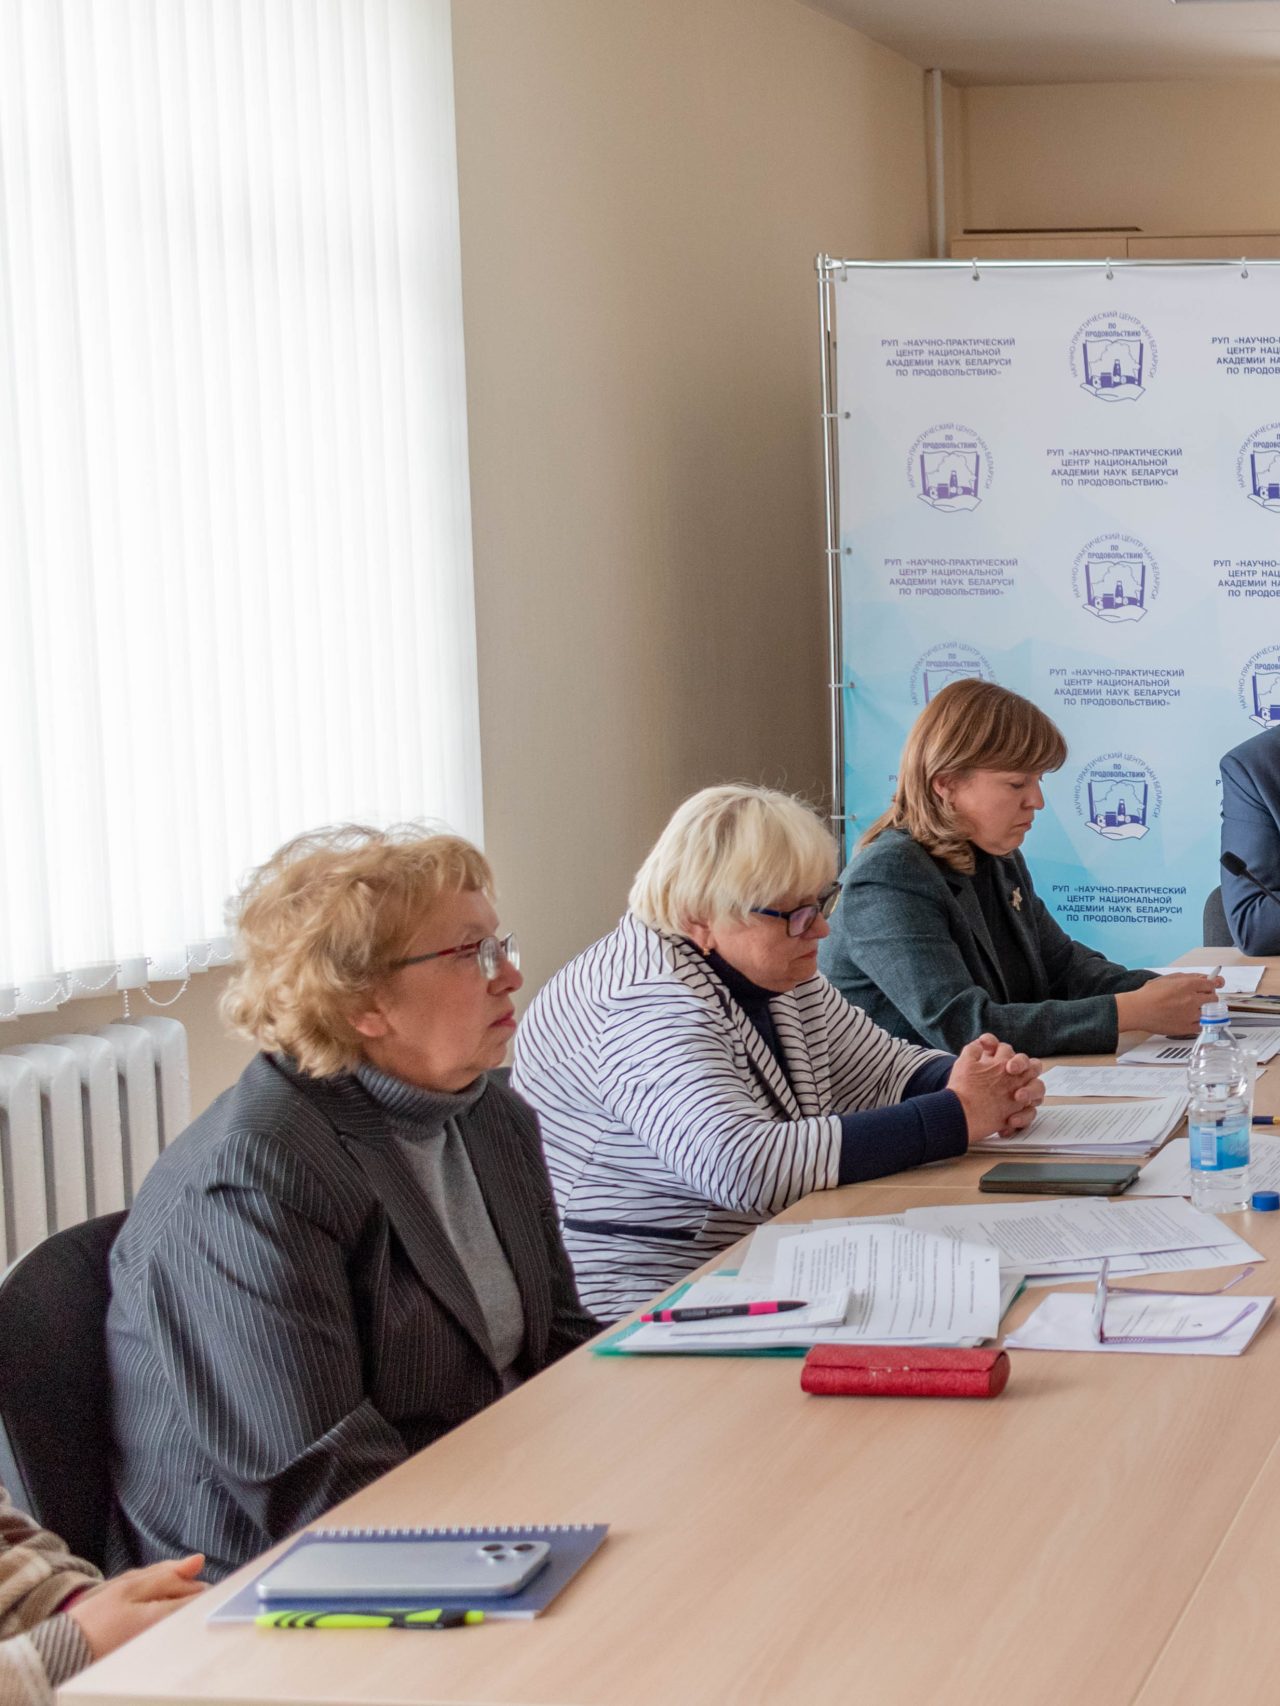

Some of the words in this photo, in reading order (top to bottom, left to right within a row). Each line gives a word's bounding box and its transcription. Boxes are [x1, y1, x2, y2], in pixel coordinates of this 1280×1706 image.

[880, 338, 898, 347] РУП
[1212, 336, 1230, 344] РУП
[896, 348, 924, 357] ЦЕНТР
[928, 348, 1002, 357] НАЦИОНАЛЬНОЙ
[1226, 346, 1256, 355] ЦЕНТР
[886, 358, 934, 367] АКАДЕМИИ
[938, 358, 962, 367] НАУК
[964, 358, 1012, 367] БЕЛАРУСИ
[1216, 356, 1266, 364] АКАДЕМИИ
[896, 368, 908, 377] ПО
[1226, 366, 1240, 375] ПО
[1046, 448, 1064, 457] РУП
[1060, 458, 1090, 467] ЦЕНТР
[1094, 458, 1168, 467] НАЦИОНАЛЬНОЙ
[1050, 468, 1100, 477] АКАДЕМИИ
[1104, 468, 1128, 477] НАУК
[1130, 468, 1178, 477] БЕЛАРУСИ
[1060, 478, 1074, 487] ПО
[884, 558, 902, 567] РУП
[1214, 559, 1232, 568] РУП
[898, 568, 928, 577] ЦЕНТР
[930, 568, 1004, 577] НАЦИОНАЛЬНОЙ
[1228, 569, 1258, 578] ЦЕНТР
[890, 577, 938, 586] АКАДЕМИИ
[940, 577, 964, 586] НАУК
[968, 577, 1014, 586] БЕЛАРУСИ
[1218, 579, 1268, 588] АКАДЕМИИ
[898, 587, 912, 596] ПО
[1228, 589, 1242, 598] ПО
[1050, 668, 1068, 677] РУП
[1064, 678, 1094, 687] ЦЕНТР
[1096, 678, 1170, 687] НАЦИОНАЛЬНОЙ
[1054, 688, 1102, 697] АКАДЕМИИ
[1106, 688, 1130, 697] НАУК
[1134, 688, 1180, 697] БЕЛАРУСИ
[1064, 698, 1076, 707] ПО
[1052, 884, 1070, 893] РУП
[1066, 894, 1096, 903] ЦЕНТР
[1098, 894, 1172, 904] НАЦИОНАЛЬНОЙ
[1056, 904, 1104, 914] АКАДЕМИИ
[1108, 905, 1132, 914] НАУК
[1136, 906, 1182, 915] БЕЛАРУСИ
[1066, 913, 1078, 922] ПО
